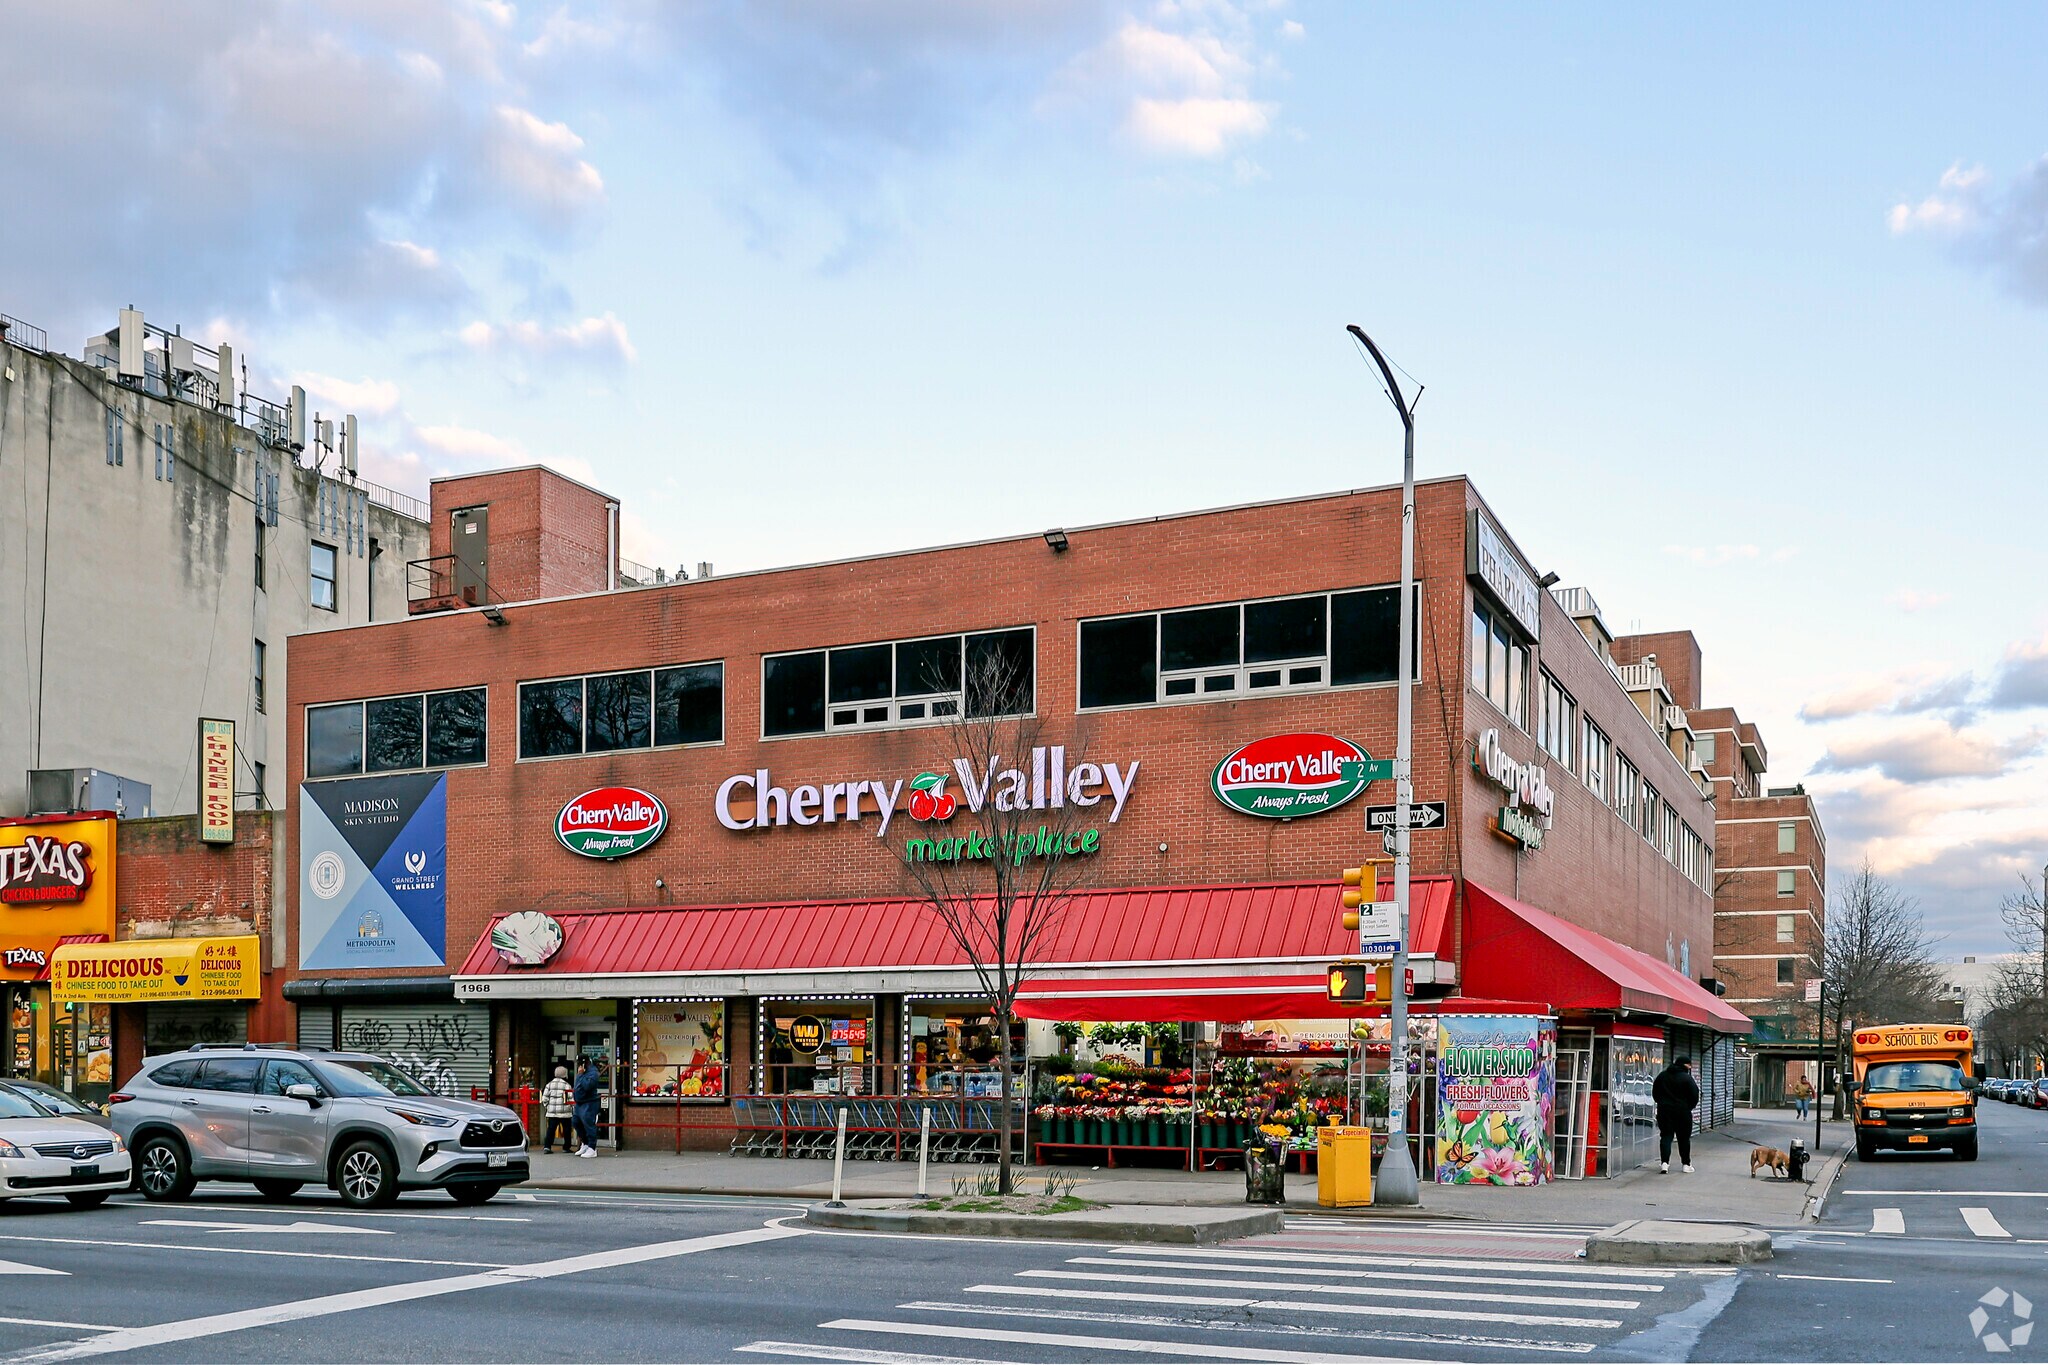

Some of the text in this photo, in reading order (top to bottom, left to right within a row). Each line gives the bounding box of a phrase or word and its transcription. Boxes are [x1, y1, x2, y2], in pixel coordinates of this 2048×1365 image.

[1482, 545, 1539, 637] PHARMACY
[1226, 757, 1295, 785] Cherry
[1357, 763, 1379, 779] 2 Av
[1479, 727, 1555, 830] Cherry Valley
[715, 745, 1140, 838] Cherry Valley
[344, 797, 399, 814] MADISON
[1250, 790, 1330, 811] Always Fresh
[344, 815, 399, 827] SKIN STUDIO
[566, 800, 657, 828] Cherry Valley
[1410, 810, 1433, 822] WAY
[581, 835, 635, 853] Always Fresh
[0, 837, 85, 890] TEXAS
[391, 875, 440, 884] GRAND STREET
[395, 882, 435, 891] WELLNESS
[2, 887, 35, 902] CHICKEN
[41, 885, 77, 900] BURGERS
[1362, 904, 1371, 915] 2
[346, 939, 396, 948] METROPOLITAN
[5, 948, 46, 967] TEXAS
[200, 959, 242, 971] DELICIOUS
[67, 957, 164, 979] DELICIOUS
[200, 971, 242, 979] CHINESE FOOD
[66, 979, 164, 990] CHINESE FOOD TO TAKE OUT
[461, 984, 491, 993] 1968
[644, 1013, 712, 1022] CHERRY VALLEY
[832, 1029, 866, 1040] 875 645
[1885, 1033, 1939, 1047] SCHOOL BUS
[1444, 1048, 1533, 1076] FLOWER SHOP
[1447, 1085, 1529, 1100] FRESH FLOWERS
